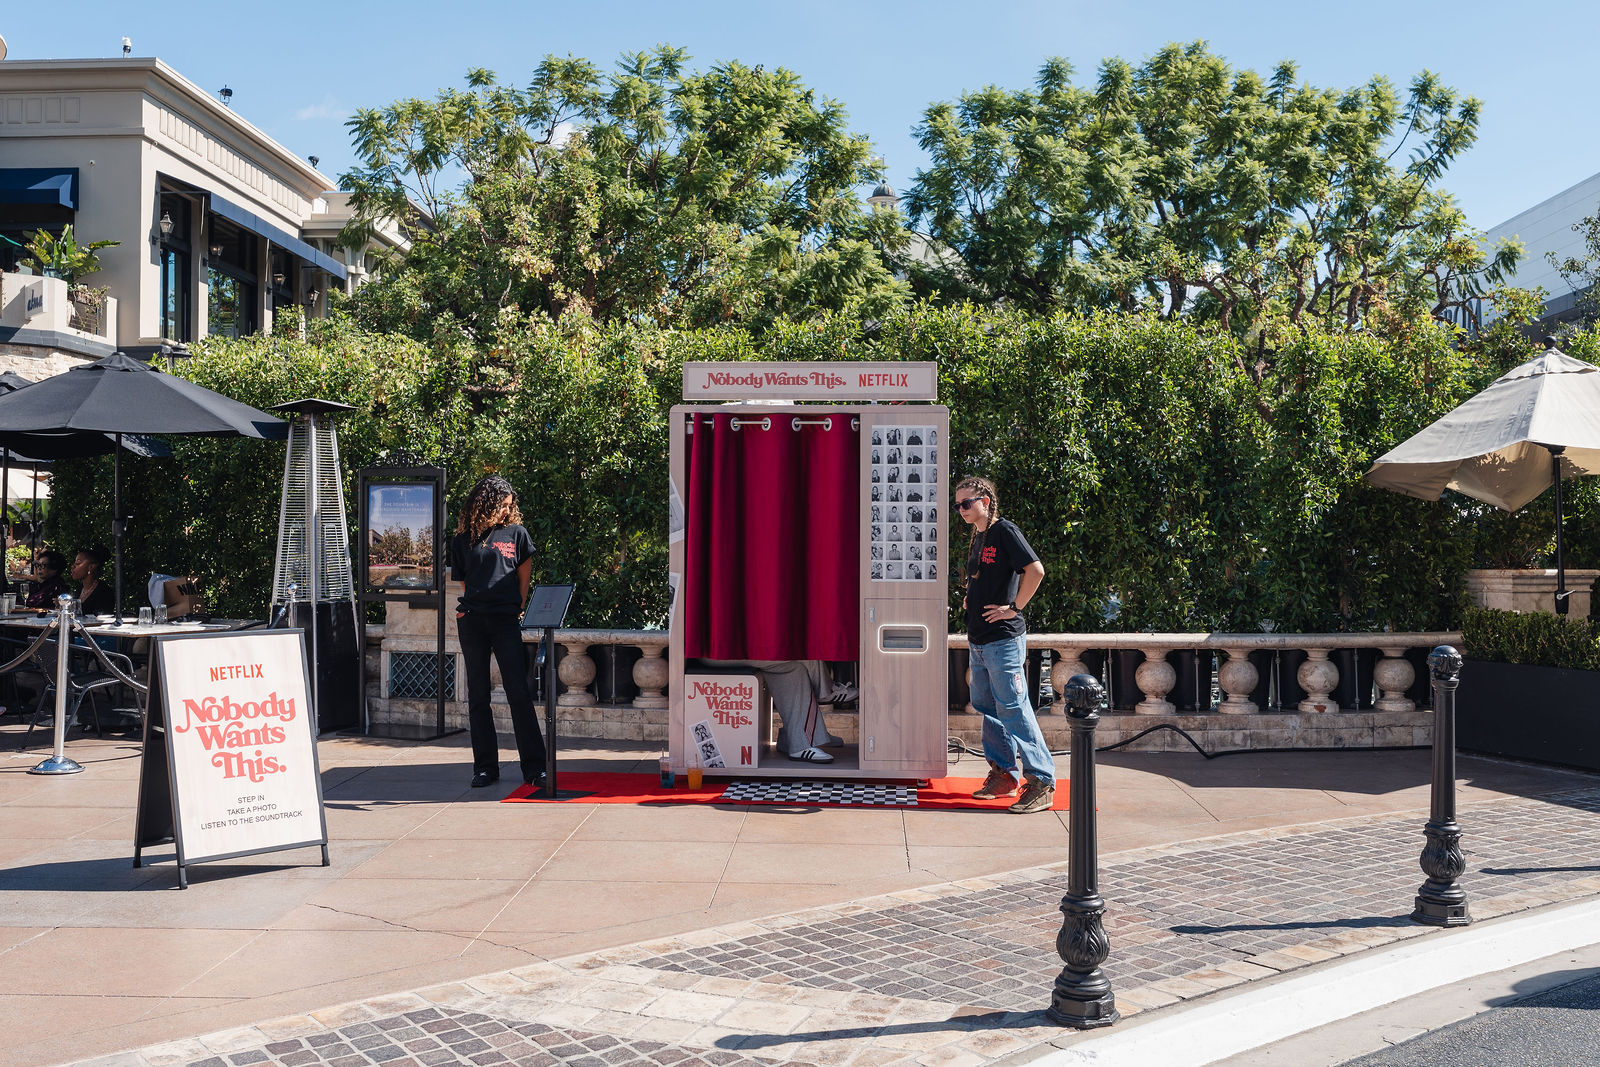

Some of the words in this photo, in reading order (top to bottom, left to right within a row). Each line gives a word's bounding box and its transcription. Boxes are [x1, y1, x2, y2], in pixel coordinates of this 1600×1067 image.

[702, 372, 763, 389] Nobody
[764, 372, 808, 386] Wants
[809, 372, 847, 389] This.
[859, 373, 908, 387] NETFLIX
[210, 664, 264, 682] NETFLIX
[687, 682, 753, 699] Nobody
[175, 692, 296, 733] Nobody
[705, 696, 753, 711] Wants
[712, 710, 753, 729] This.
[196, 721, 286, 751] Wants
[740, 745, 752, 765] N
[211, 749, 287, 783] This.
[237, 795, 257, 804] STEP
[227, 807, 246, 816] TAKE
[252, 803, 277, 813] PHOTO
[200, 820, 227, 830] LISTEN
[228, 818, 238, 826] TO
[240, 816, 254, 824] THE
[255, 810, 303, 823] SOUNDTRACK
